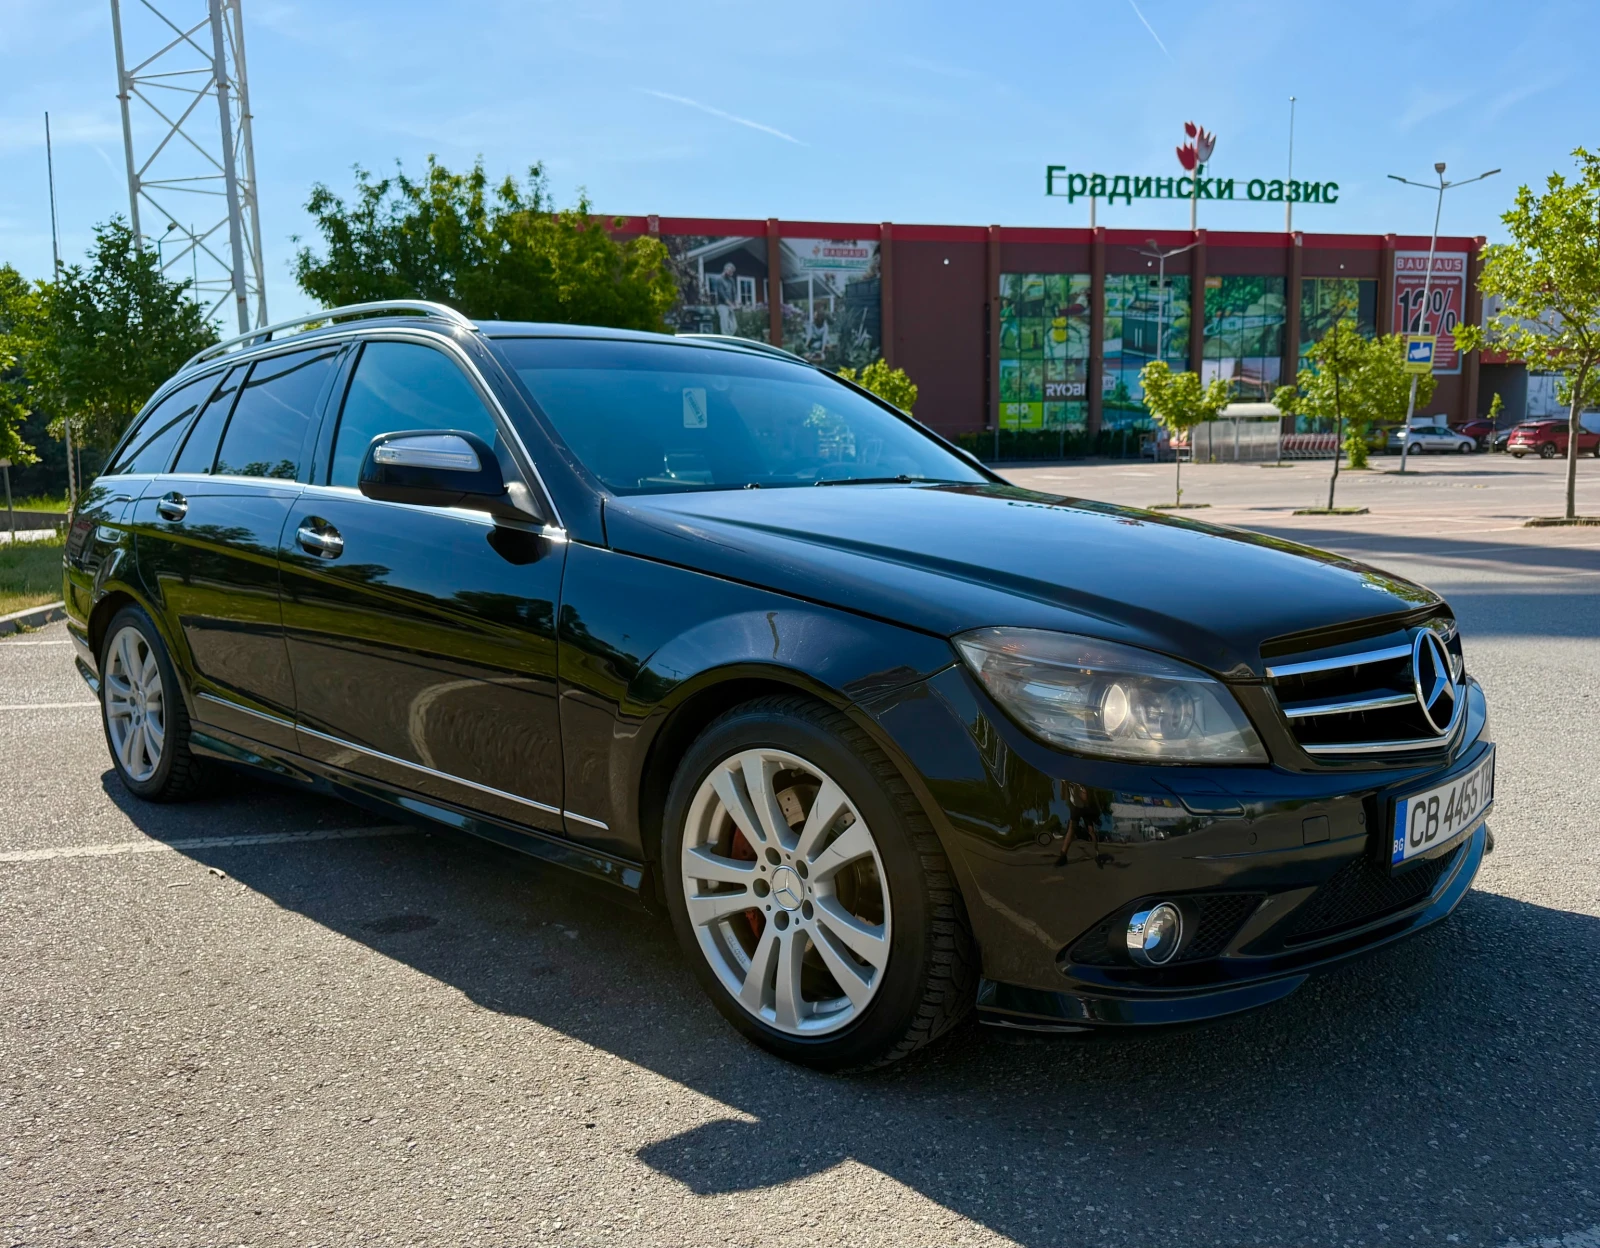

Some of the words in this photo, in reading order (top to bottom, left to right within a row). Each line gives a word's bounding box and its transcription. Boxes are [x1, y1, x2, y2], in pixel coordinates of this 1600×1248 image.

[1046, 164, 1234, 206] Градински
[1246, 177, 1340, 204] оазис
[1397, 287, 1457, 337] 12%
[1045, 382, 1086, 397] RYOBI
[1409, 795, 1440, 848] CB
[1443, 769, 1480, 832] 4455
[1393, 838, 1405, 855] BG
